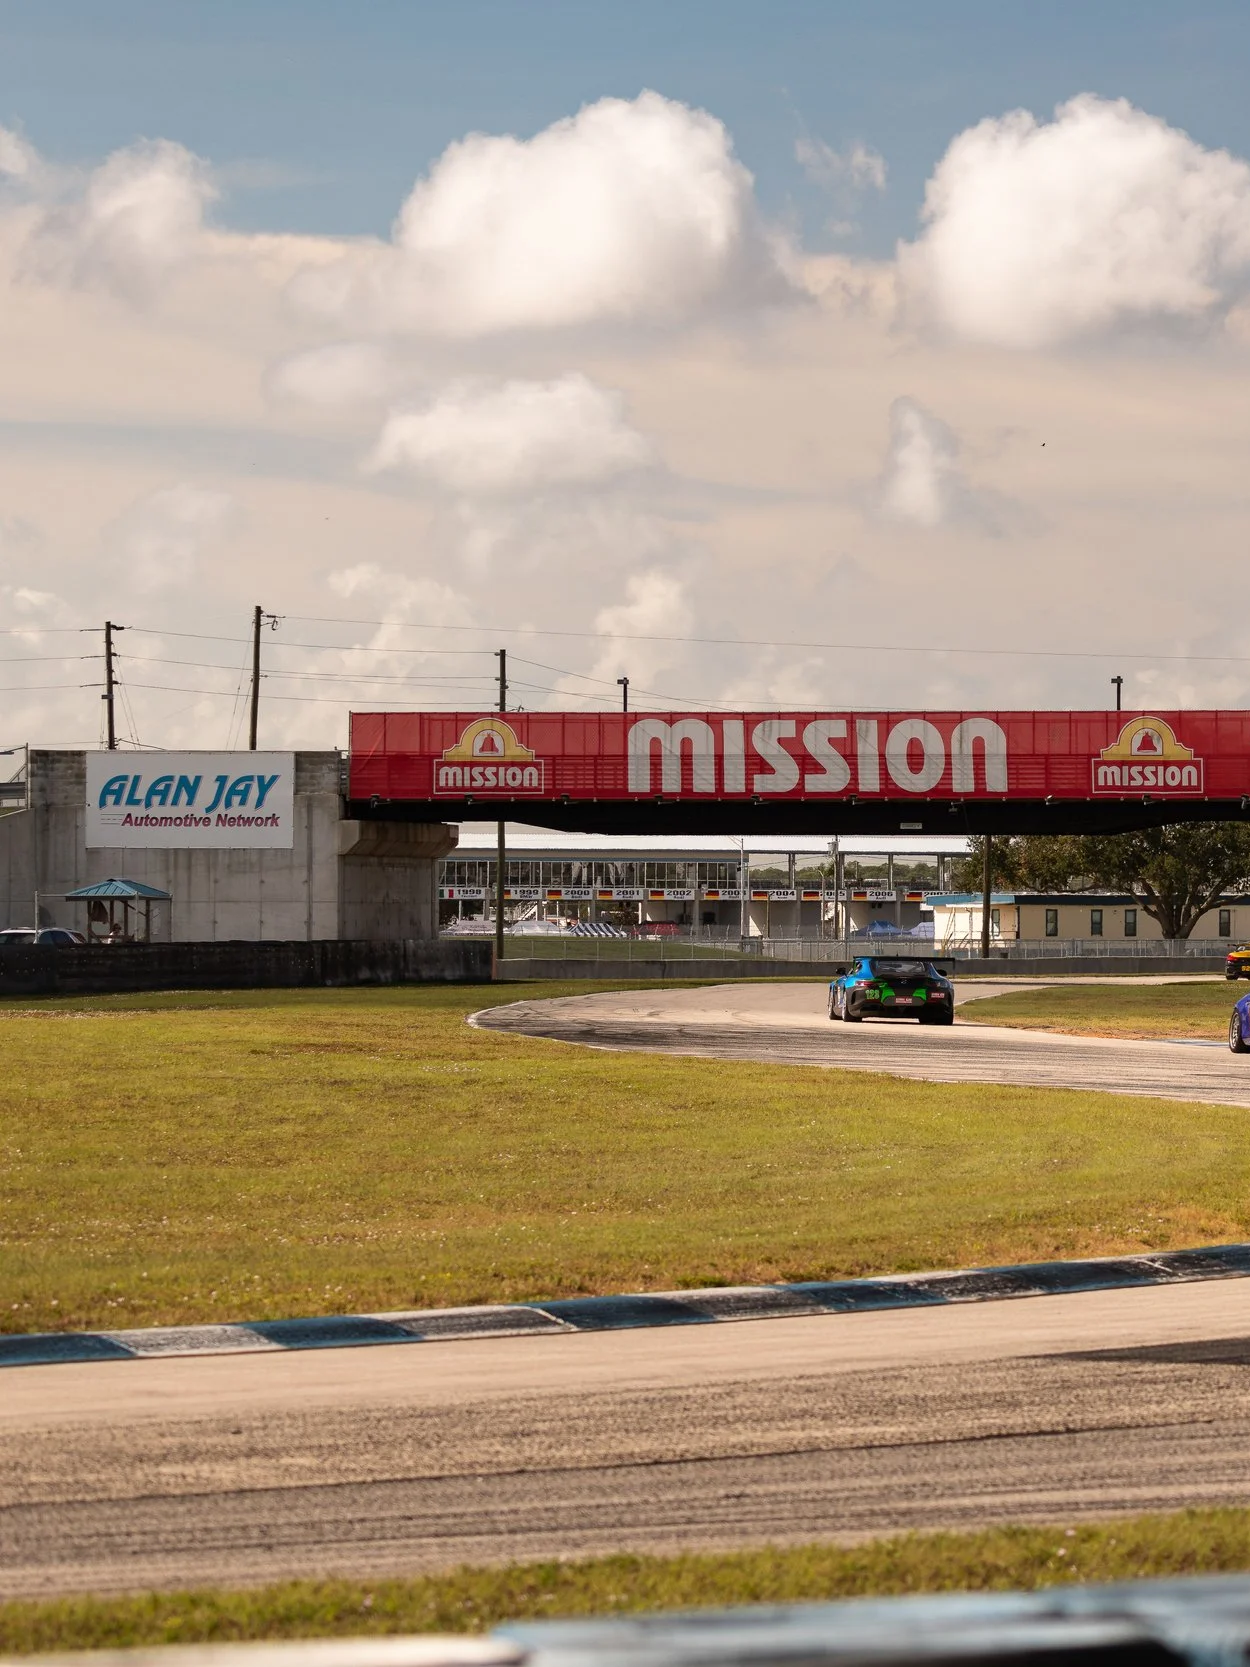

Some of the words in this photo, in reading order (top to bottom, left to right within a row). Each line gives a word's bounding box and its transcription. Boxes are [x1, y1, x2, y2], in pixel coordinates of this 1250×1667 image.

[628, 717, 1008, 793] MISSION
[439, 766, 539, 787] MISSION
[1098, 765, 1198, 787] MISSION
[99, 774, 203, 811] ALAN
[205, 774, 281, 814] JAY
[121, 812, 212, 827] Automotive
[215, 812, 281, 827] Network
